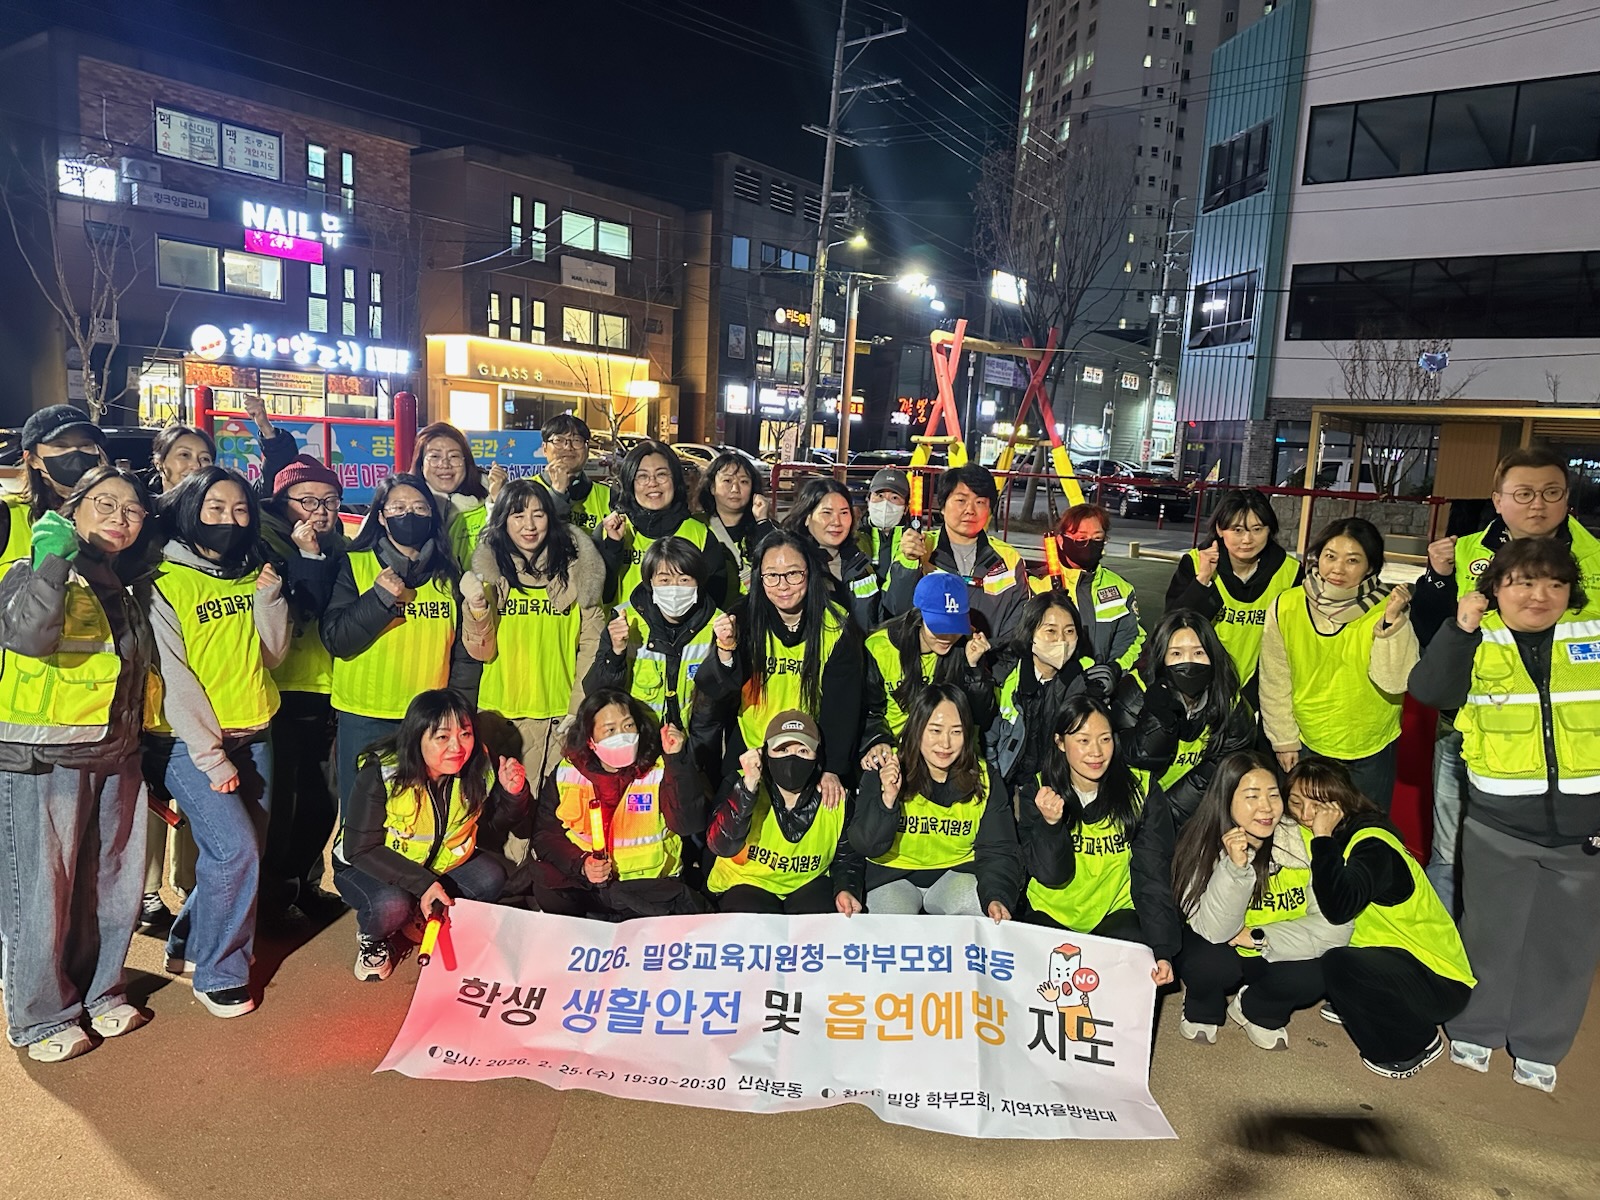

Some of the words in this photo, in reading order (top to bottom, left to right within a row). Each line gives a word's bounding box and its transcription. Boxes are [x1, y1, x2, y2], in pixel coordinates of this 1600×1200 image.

[243, 201, 316, 239] NAIL
[477, 362, 529, 381] GLASS
[474, 440, 498, 458] 공간
[196, 593, 254, 624] 밀양교육지
[394, 601, 450, 619] 교육지원청
[944, 592, 959, 613] LA
[897, 815, 972, 836] 밀양교육지원청
[747, 845, 821, 873] 밀양교육지원청
[568, 946, 630, 973] 2026.
[643, 942, 952, 973] 밀양교육지원청-학부모회
[964, 943, 1015, 981] 합동
[1075, 972, 1097, 985] NO
[456, 977, 547, 1026] 학생
[562, 987, 741, 1035] 생활안전
[762, 989, 802, 1035] 및
[825, 991, 1008, 1046] 흡연예방
[1027, 1007, 1115, 1067] 지도
[443, 1049, 481, 1067] 일시:
[486, 1057, 530, 1068] 2026.
[623, 1073, 726, 1092] 19:30~20:30
[737, 1076, 803, 1099] 신삼문동
[887, 1092, 920, 1109] 밀양
[926, 1091, 995, 1113] 학부모회,
[1000, 1098, 1117, 1123] 지역자율방범대
